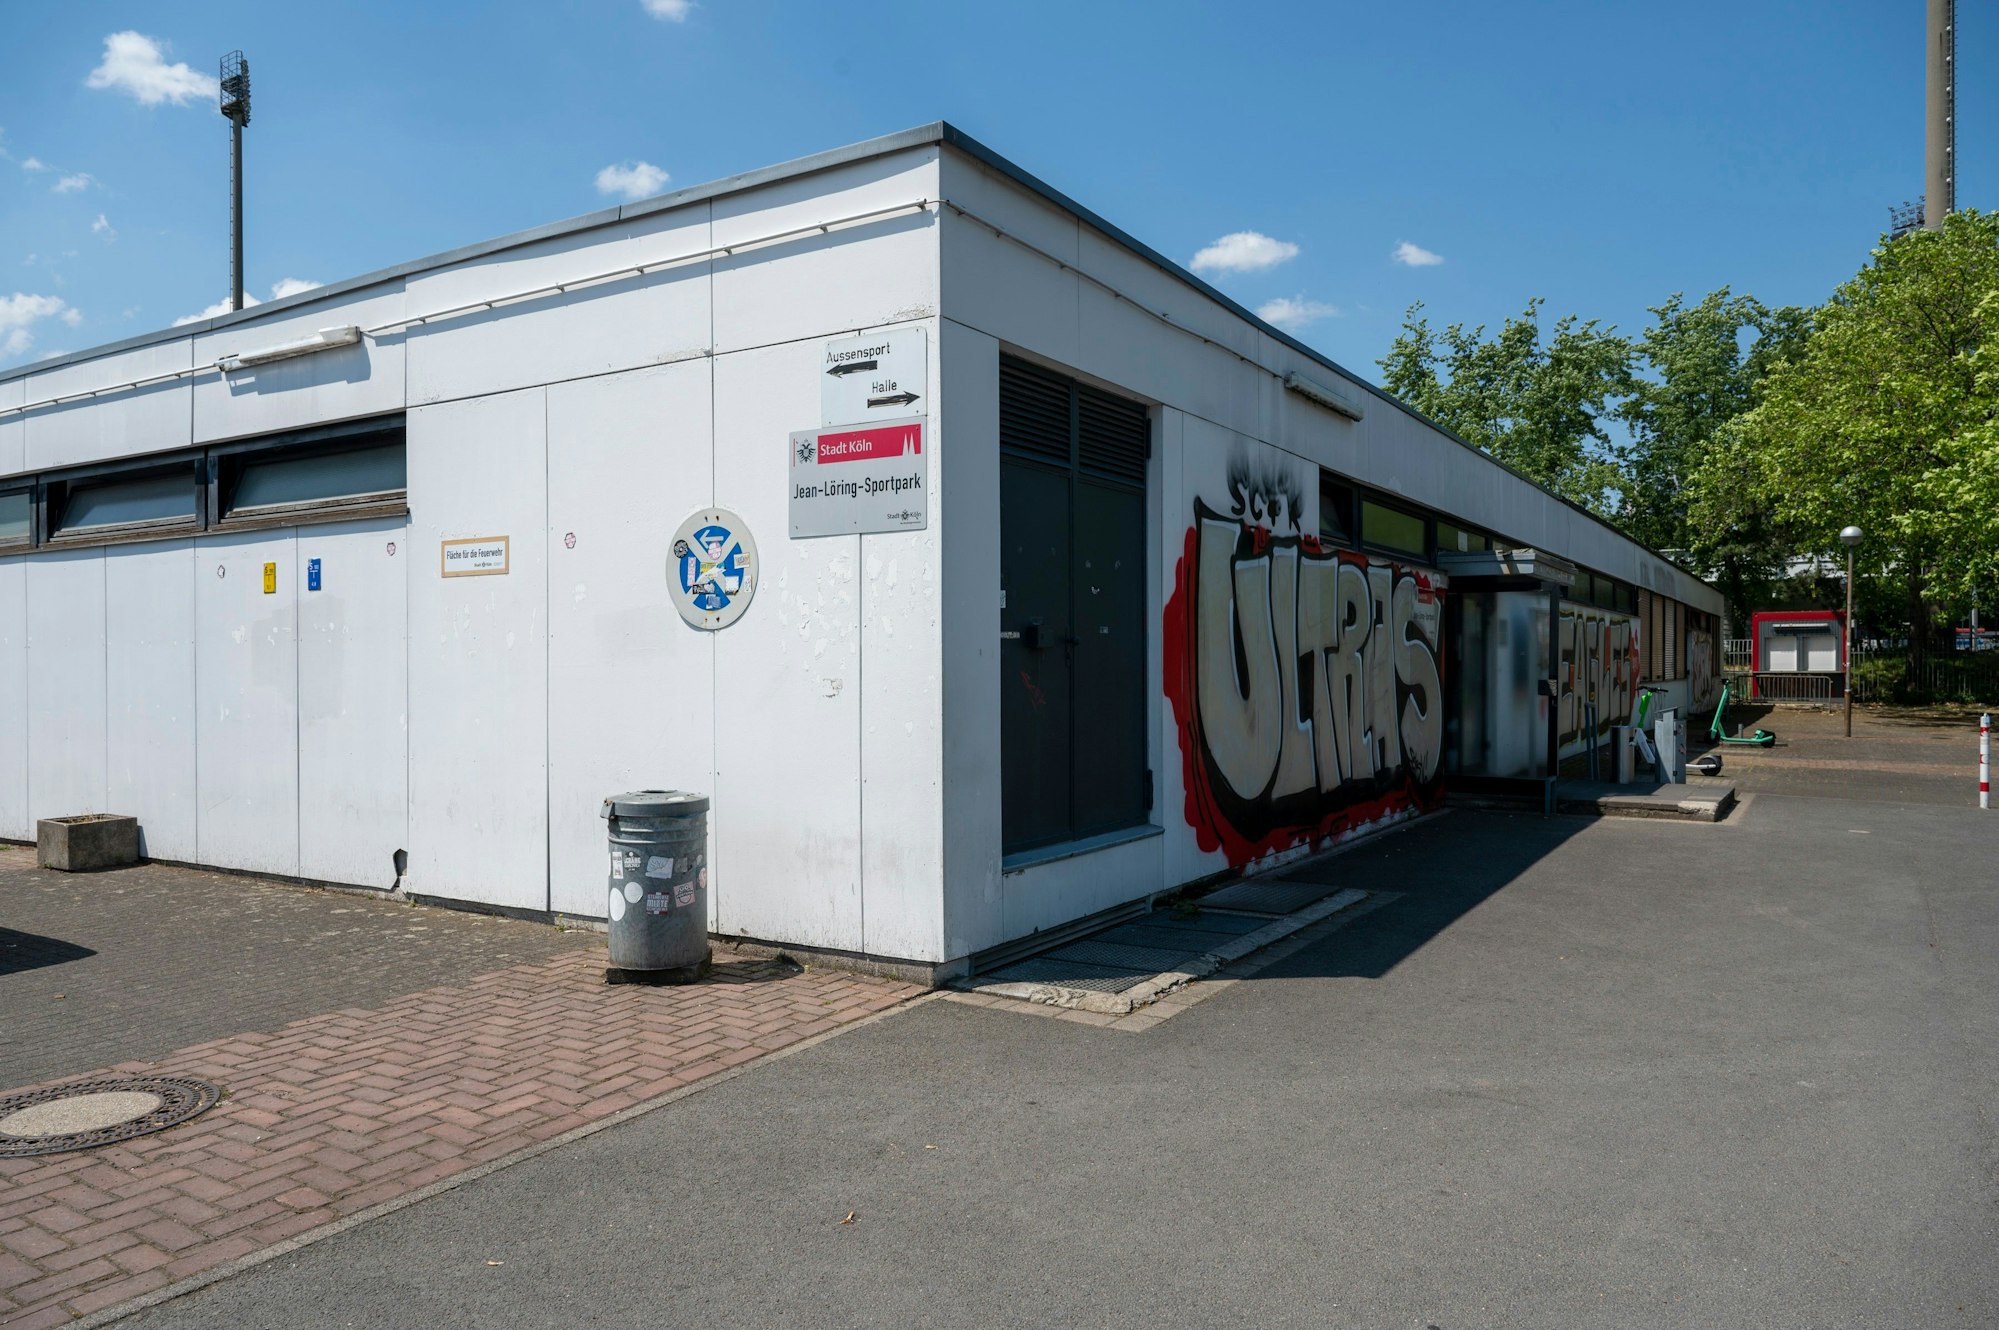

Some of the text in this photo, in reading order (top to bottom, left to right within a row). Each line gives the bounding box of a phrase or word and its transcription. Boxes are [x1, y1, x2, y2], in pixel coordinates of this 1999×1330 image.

[826, 342, 890, 364] Aussensport
[872, 380, 897, 393] Halle
[820, 439, 872, 456] Stadt Köln
[793, 473, 921, 499] Jean-Löring-Sportpark
[887, 512, 900, 520] Stadt
[446, 547, 504, 560] Fläche für die Feuerwehr
[1196, 500, 1443, 803] ULTRAS
